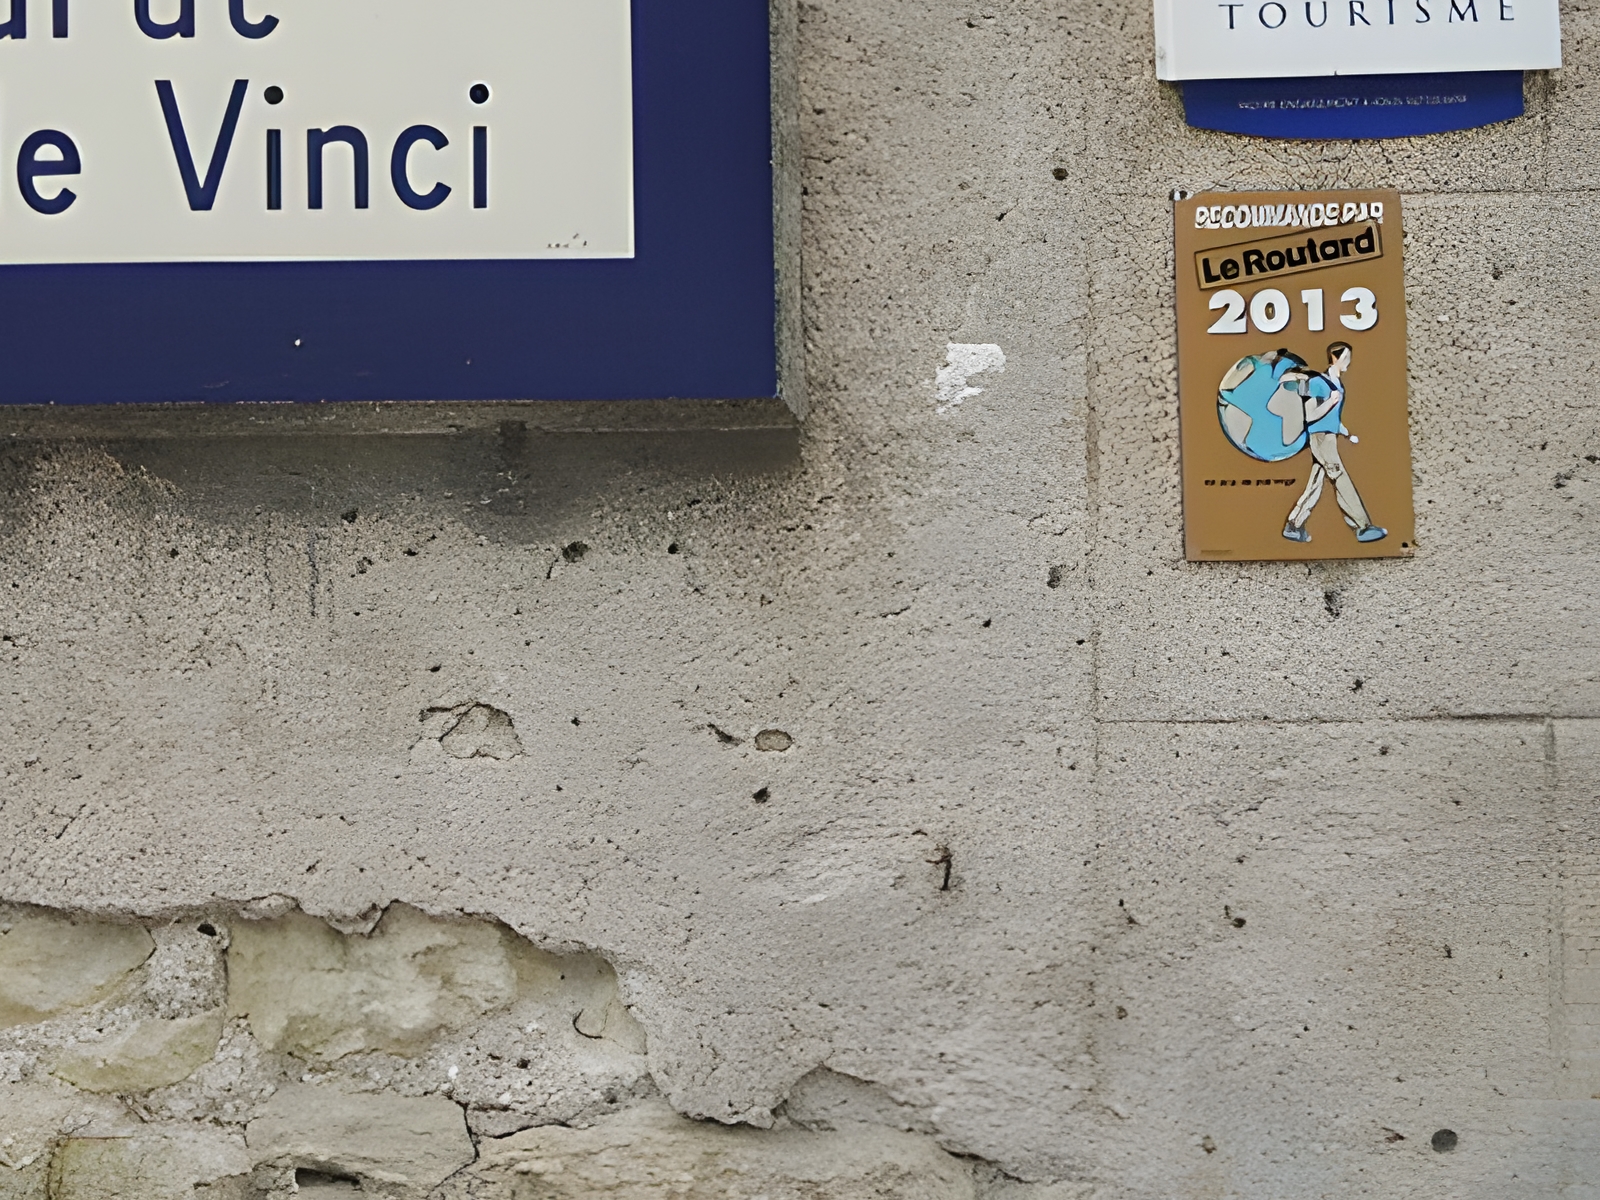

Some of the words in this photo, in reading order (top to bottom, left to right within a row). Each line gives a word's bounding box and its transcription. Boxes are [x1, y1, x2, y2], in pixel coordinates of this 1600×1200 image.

[154, 79, 489, 212] Vinci
[1202, 257, 1240, 284] Le
[1242, 225, 1376, 276] Routard
[1206, 286, 1378, 335] 2013
